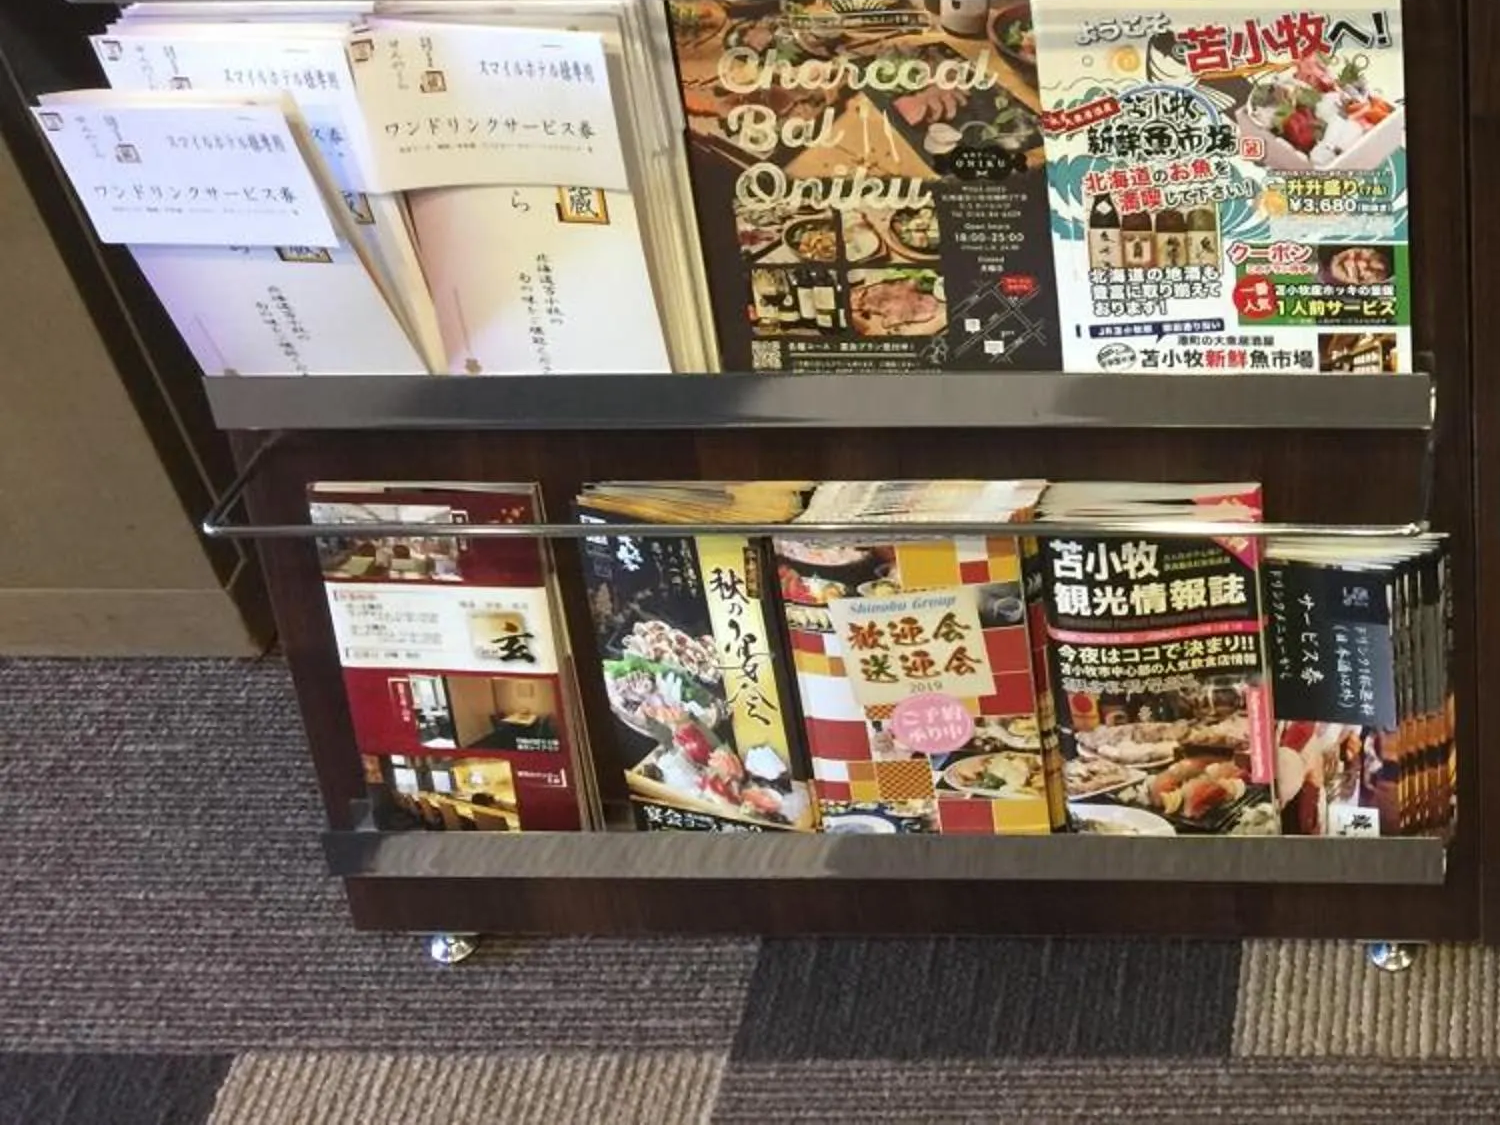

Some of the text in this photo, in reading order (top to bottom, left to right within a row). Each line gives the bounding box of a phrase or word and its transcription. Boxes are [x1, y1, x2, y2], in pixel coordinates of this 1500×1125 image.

[1075, 12, 1394, 74] ようこそ 苫小牧へ!
[717, 46, 999, 94] Charcoal
[385, 117, 596, 139] ワンドリンクサービス券
[728, 104, 845, 152] Bal
[956, 159, 1007, 169] ONIKU
[1085, 159, 1231, 194] 北海道のお魚を
[94, 184, 296, 203] ワンドリンクサービス券
[736, 161, 932, 211] Oniku
[1226, 241, 1313, 265] クーポン
[1090, 268, 1219, 284] 北海道の地酒も
[1094, 300, 1167, 317] おります!
[1140, 349, 1313, 369] 苫小牧新鮮魚市場
[1049, 538, 1159, 580] 苫小牧
[850, 595, 957, 614] Shinobu Group
[1054, 573, 1246, 616] 観光情報誌
[848, 612, 971, 650] 歓迎会
[1297, 592, 1325, 686] サービス券
[491, 632, 536, 663] 玄
[1058, 635, 1254, 663] 今夜はココで決まり!!
[860, 646, 982, 683] 送迎会
[910, 681, 943, 694] 2019
